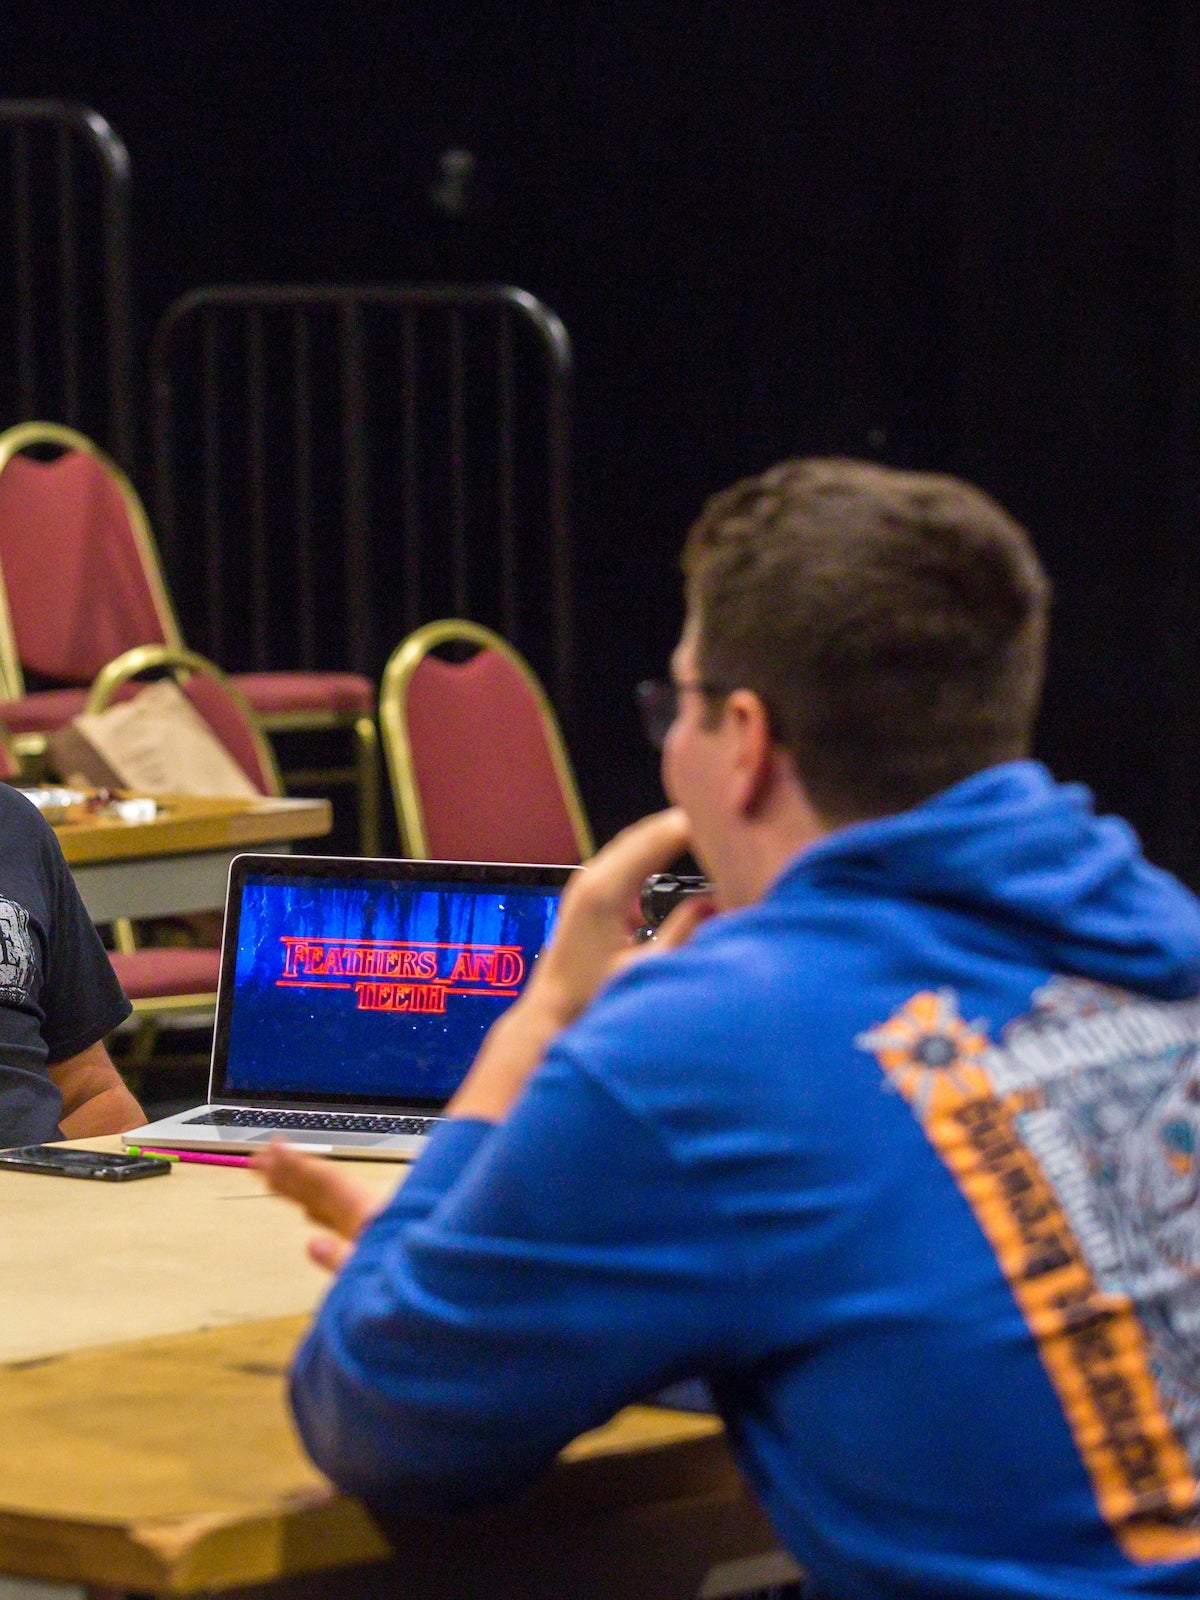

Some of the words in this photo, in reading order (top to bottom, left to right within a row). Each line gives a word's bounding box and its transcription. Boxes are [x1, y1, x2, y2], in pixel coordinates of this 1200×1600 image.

[282, 941, 438, 979] FEATHERS
[451, 948, 525, 987] AND
[355, 981, 447, 1013] TEETH
